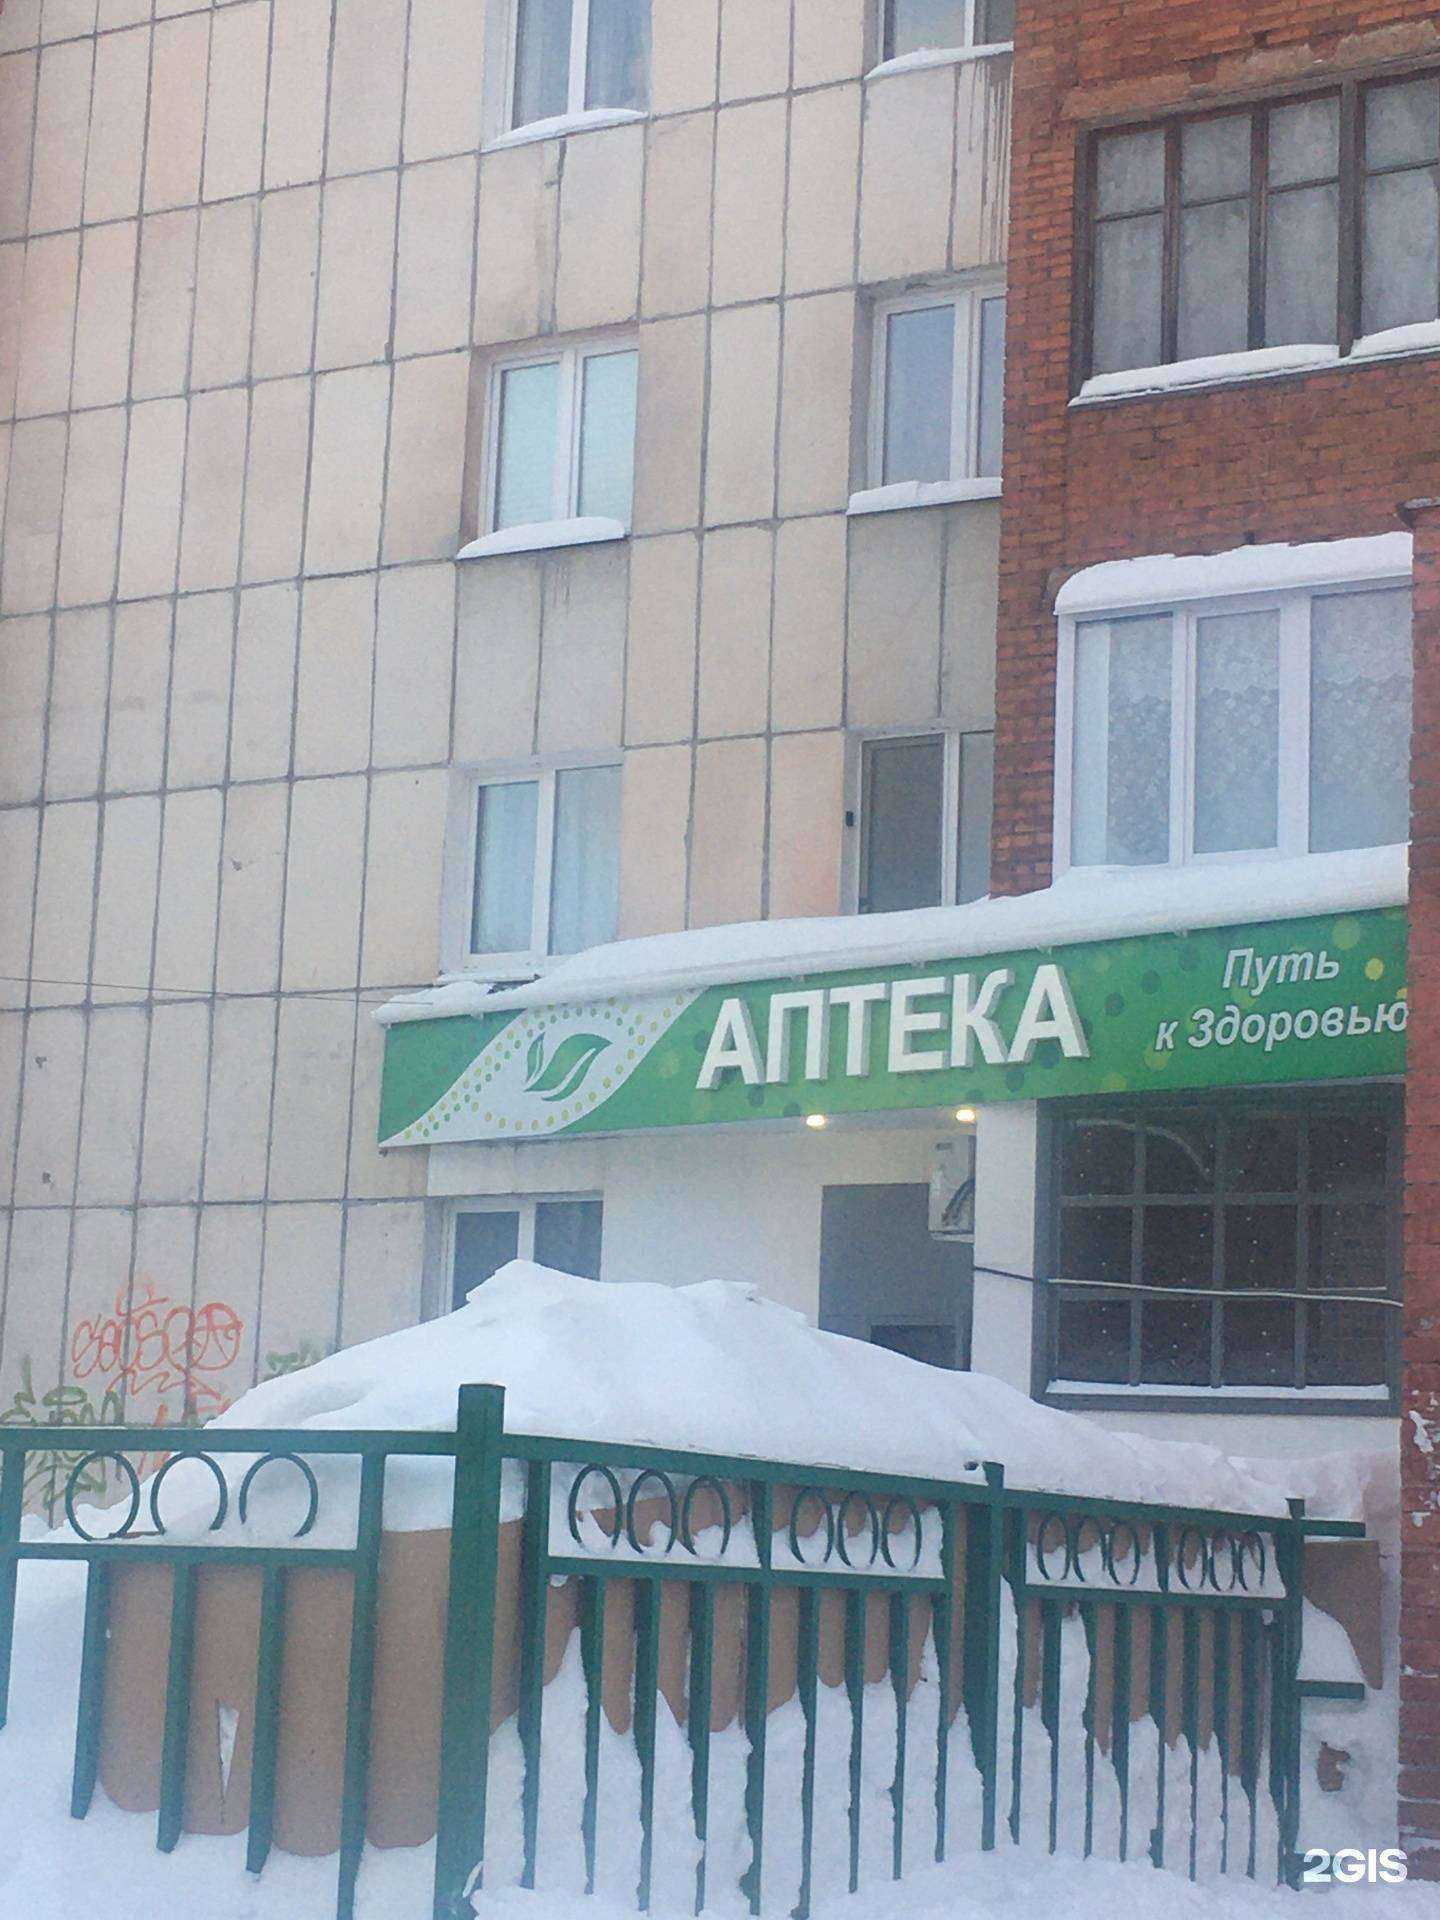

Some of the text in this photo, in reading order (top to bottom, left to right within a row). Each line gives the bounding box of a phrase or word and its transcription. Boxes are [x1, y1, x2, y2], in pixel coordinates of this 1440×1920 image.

[1222, 948, 1340, 996] Путь
[696, 964, 1090, 1090] АПТЕКА
[1155, 1001, 1409, 1051] к Здоровью
